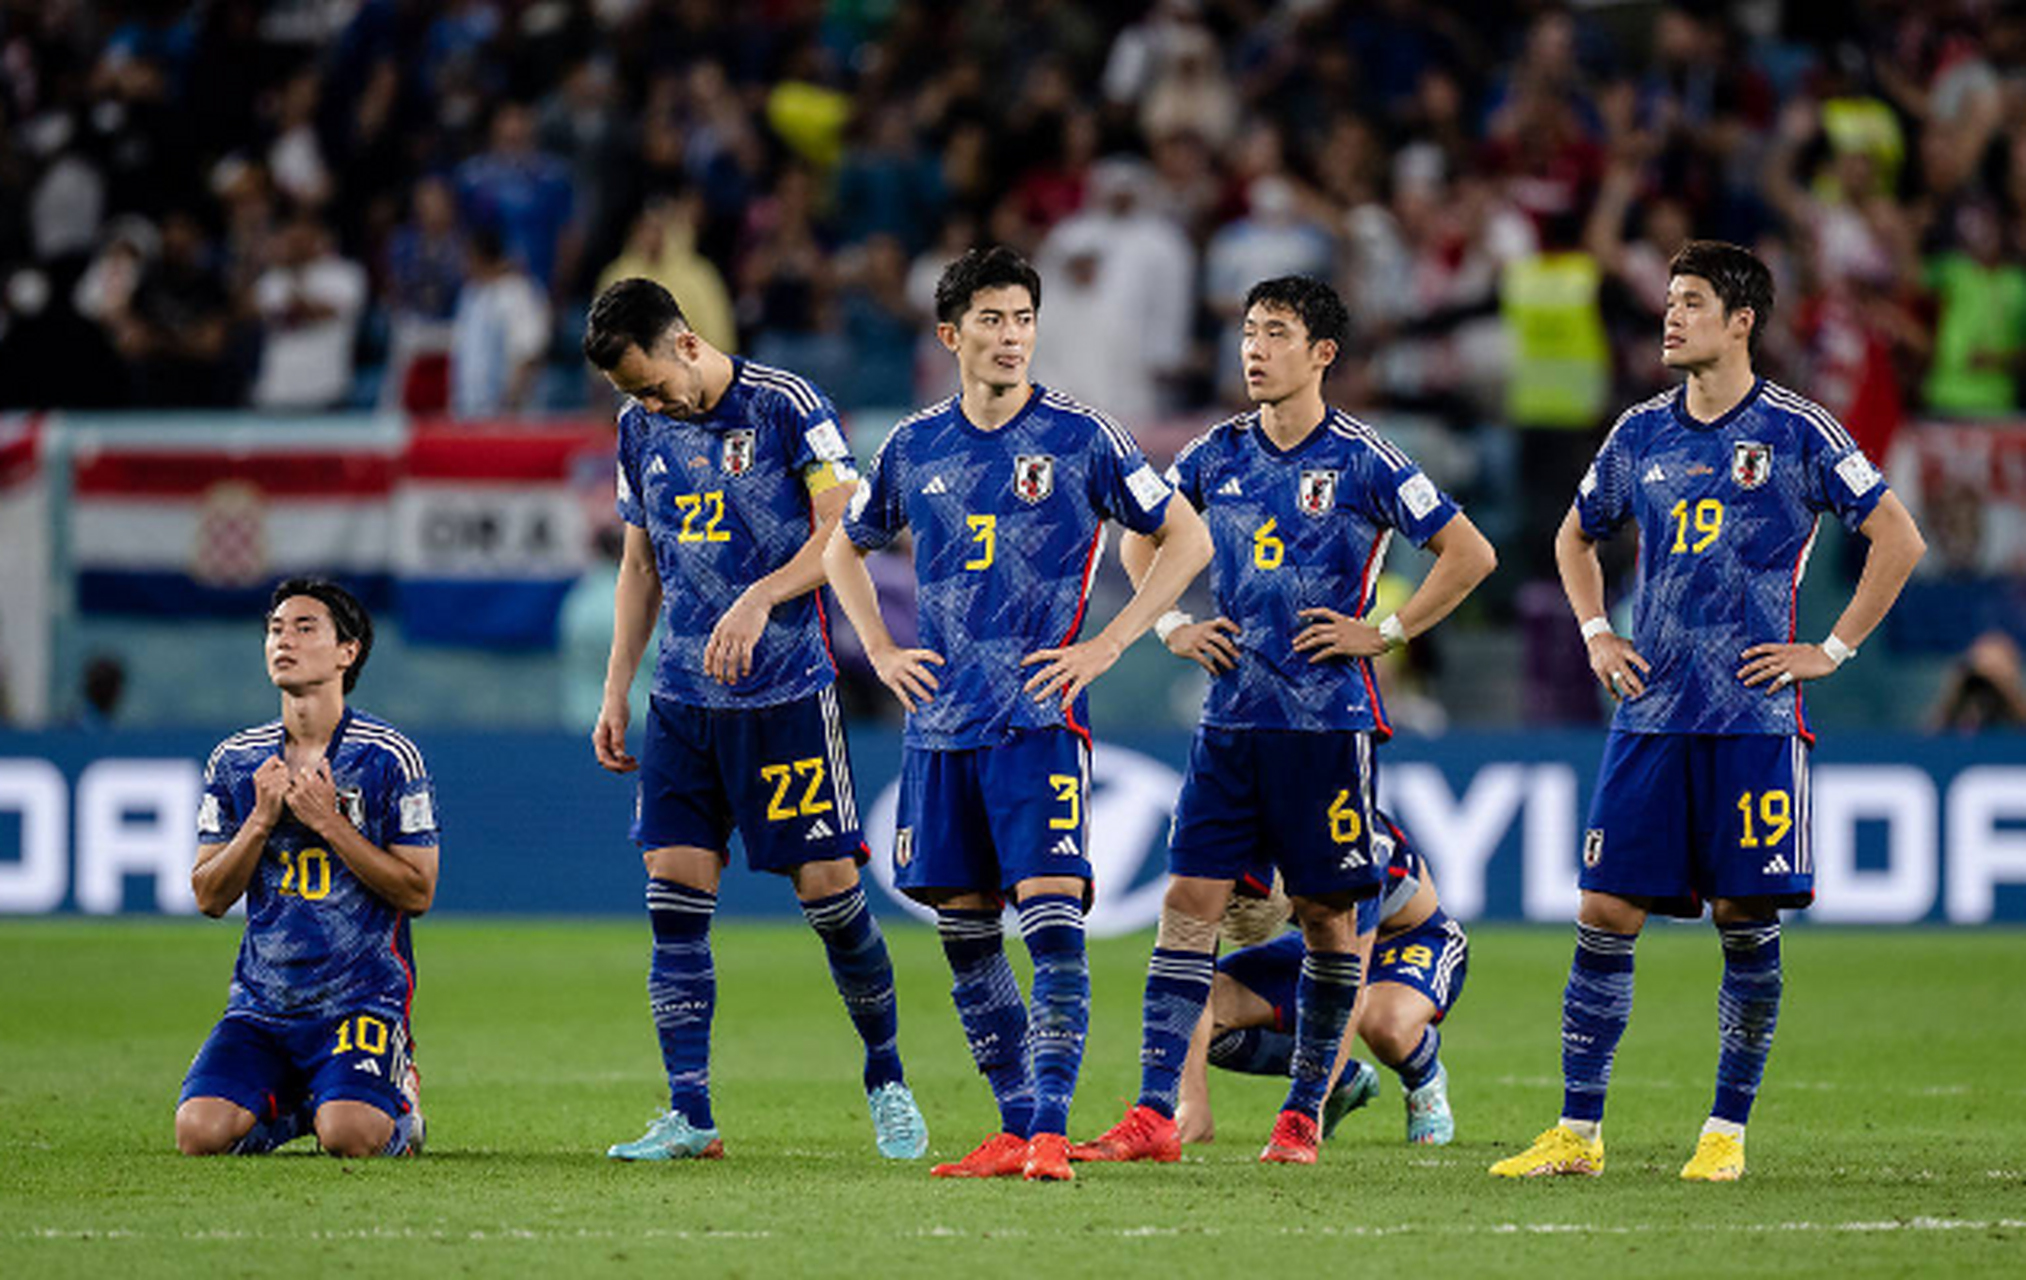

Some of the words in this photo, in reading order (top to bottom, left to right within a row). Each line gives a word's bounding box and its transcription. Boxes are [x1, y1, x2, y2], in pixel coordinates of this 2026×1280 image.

[674, 489, 731, 543] 22
[965, 514, 996, 571] 3
[1253, 517, 1285, 570] 6
[1670, 498, 1724, 554] 19
[761, 756, 833, 821] 22
[1049, 774, 1080, 830] 3
[1327, 789, 1362, 844] 6
[0, 758, 247, 914] DA
[1736, 789, 1793, 848] 19
[278, 847, 331, 901] 10
[332, 1015, 388, 1056] 10
